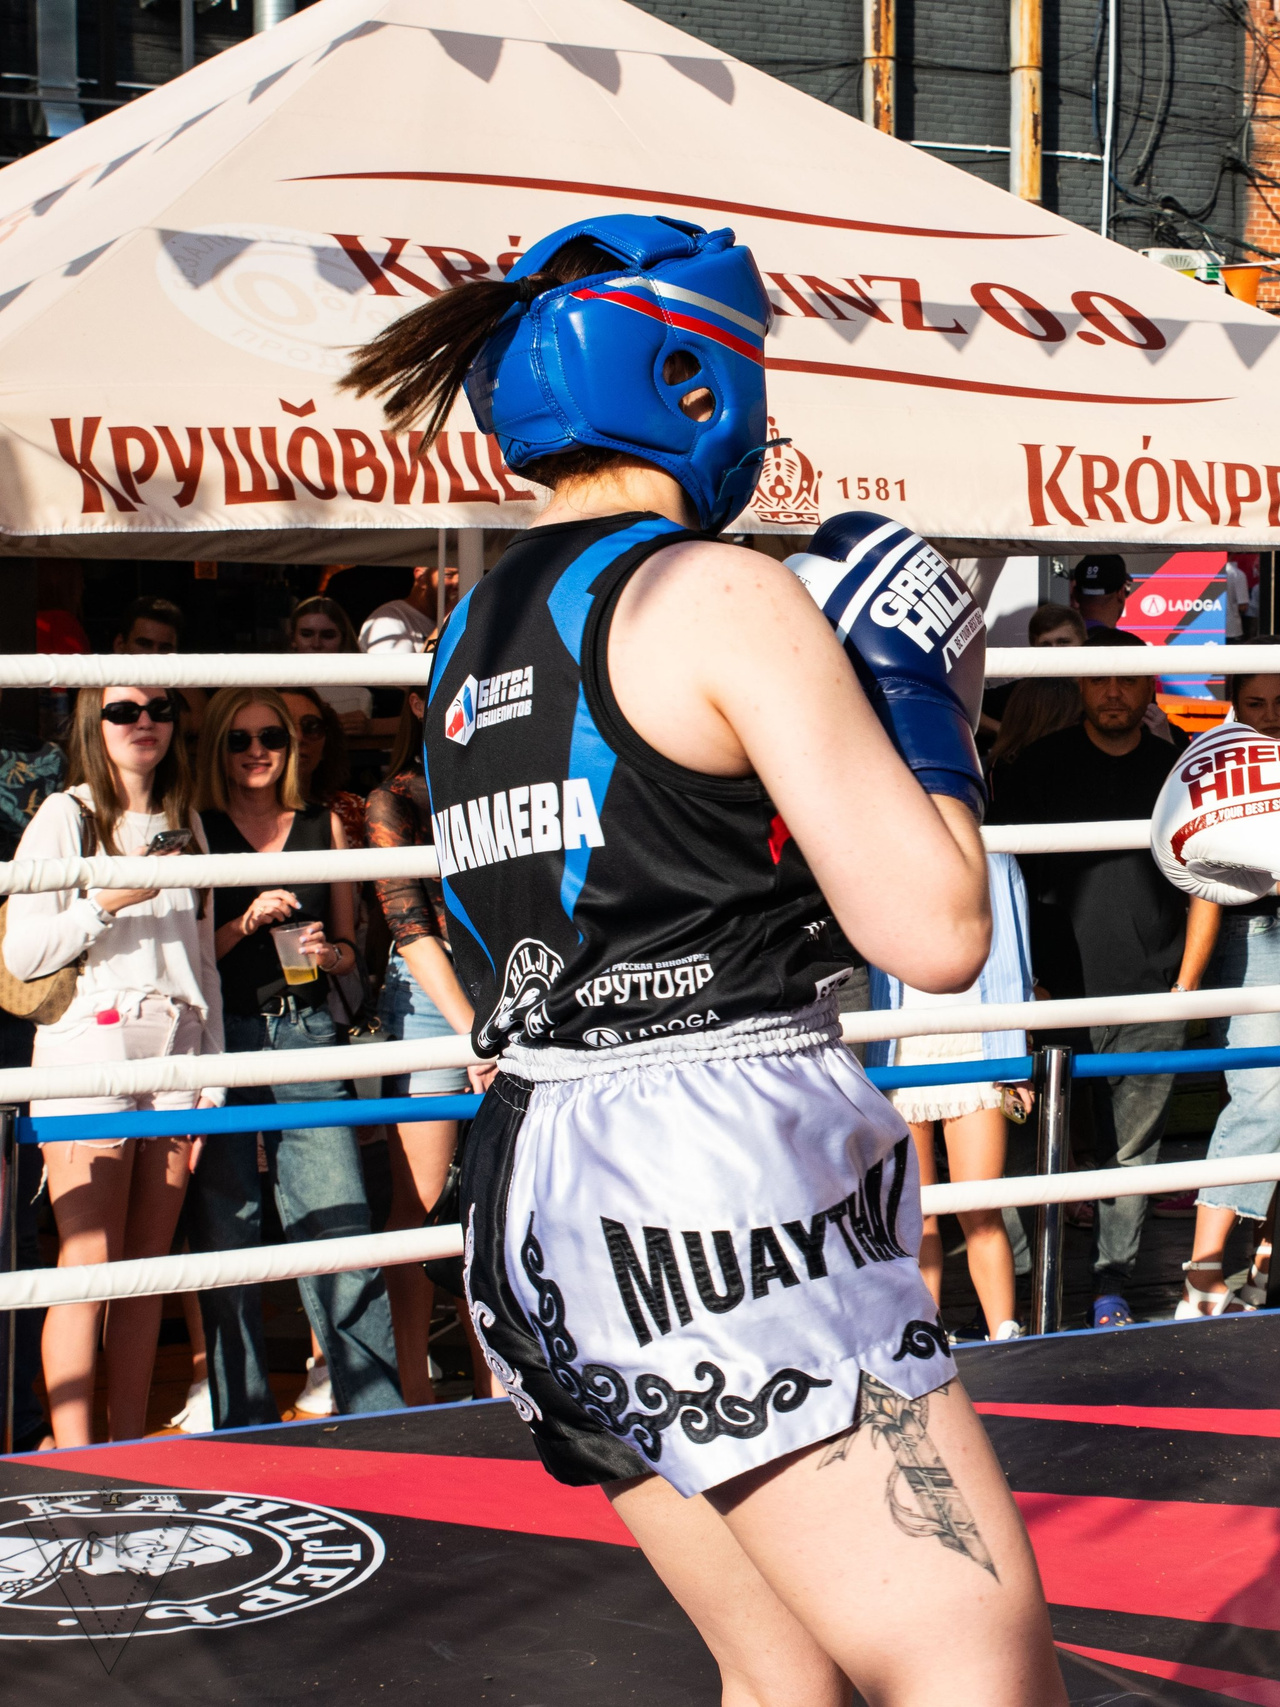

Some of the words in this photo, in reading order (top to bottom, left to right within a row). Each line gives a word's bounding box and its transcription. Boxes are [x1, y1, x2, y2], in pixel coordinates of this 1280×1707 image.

[837, 476, 906, 502] 1581
[869, 544, 950, 628] GREE
[897, 572, 973, 654] HILL
[1168, 598, 1223, 612] LADOGA
[1245, 801, 1270, 815] BEST
